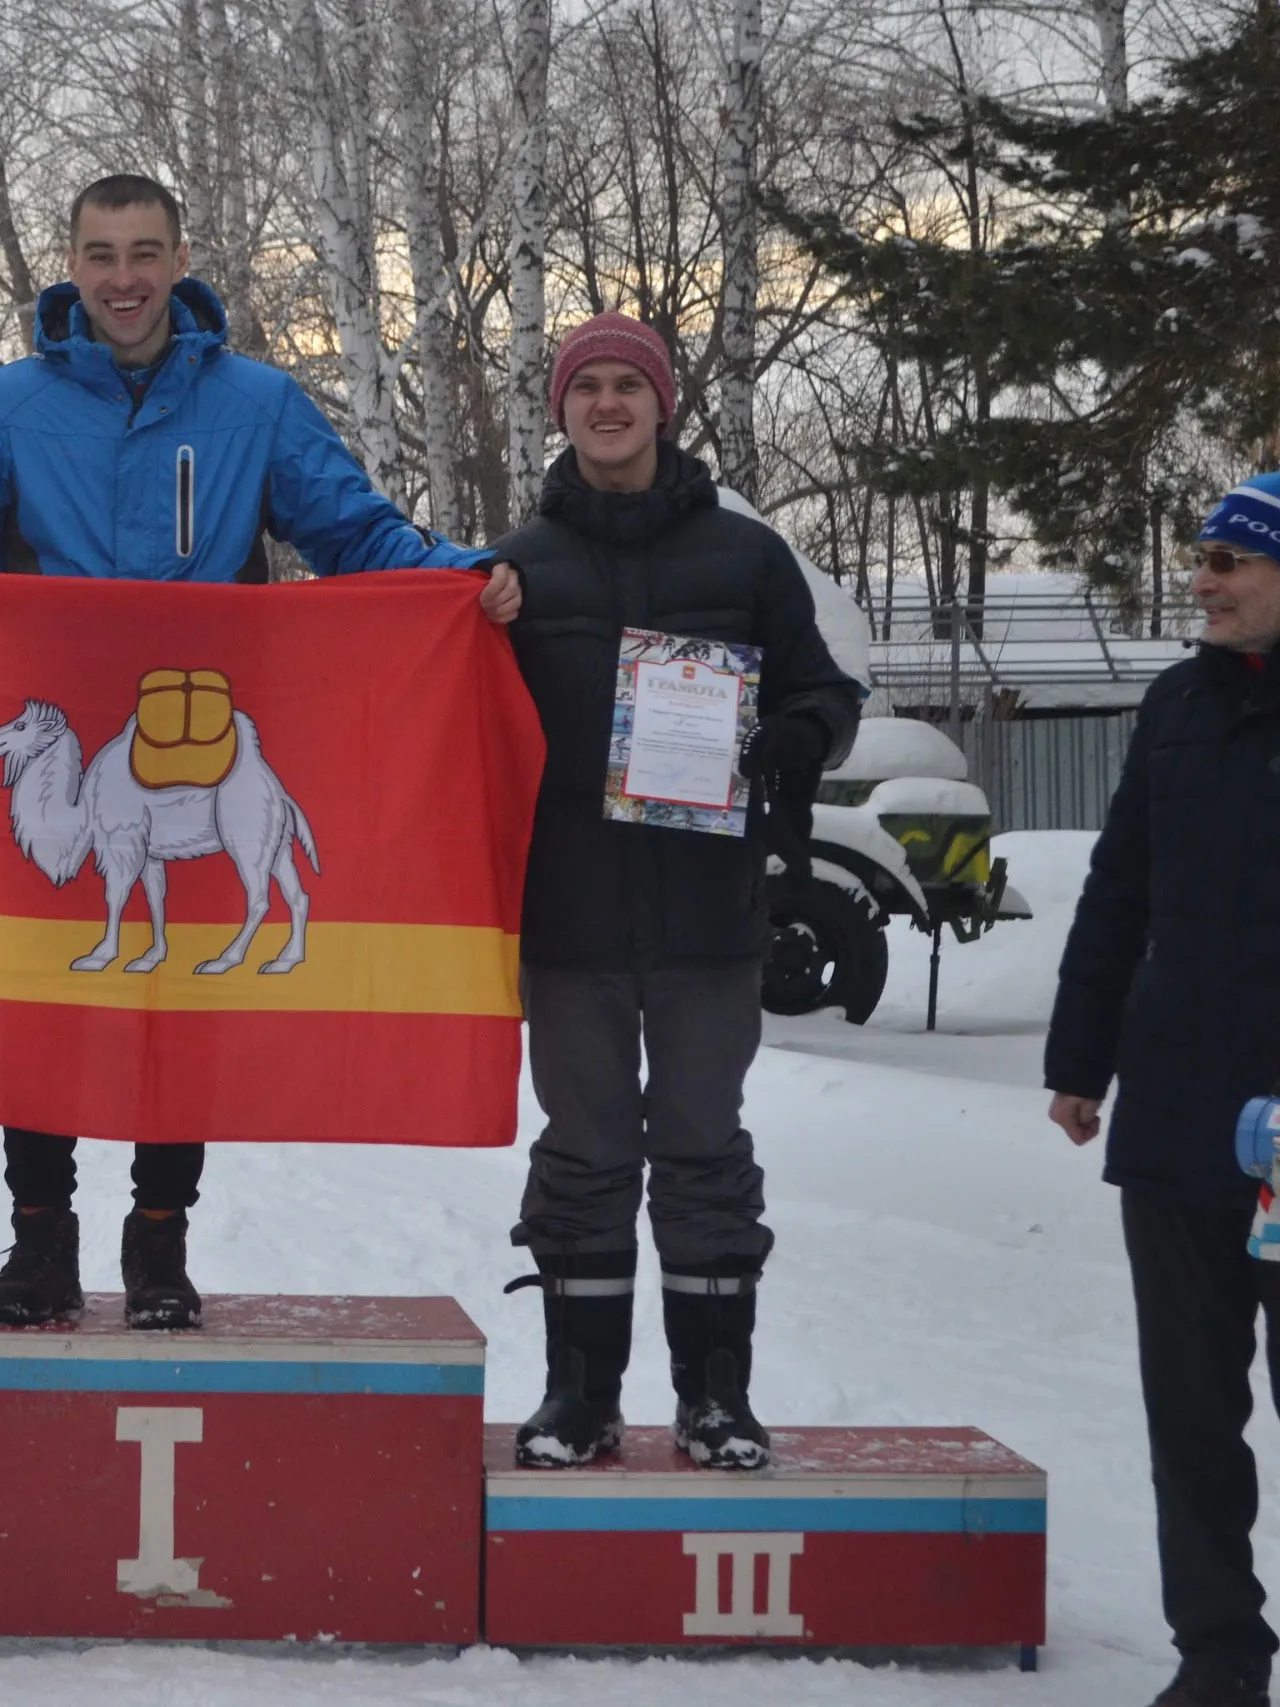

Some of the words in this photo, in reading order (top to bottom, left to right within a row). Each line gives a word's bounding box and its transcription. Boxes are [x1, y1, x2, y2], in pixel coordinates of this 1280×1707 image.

[646, 677, 728, 700] ГРАМОТА
[116, 1407, 204, 1597] I
[682, 1532, 804, 1636] III
